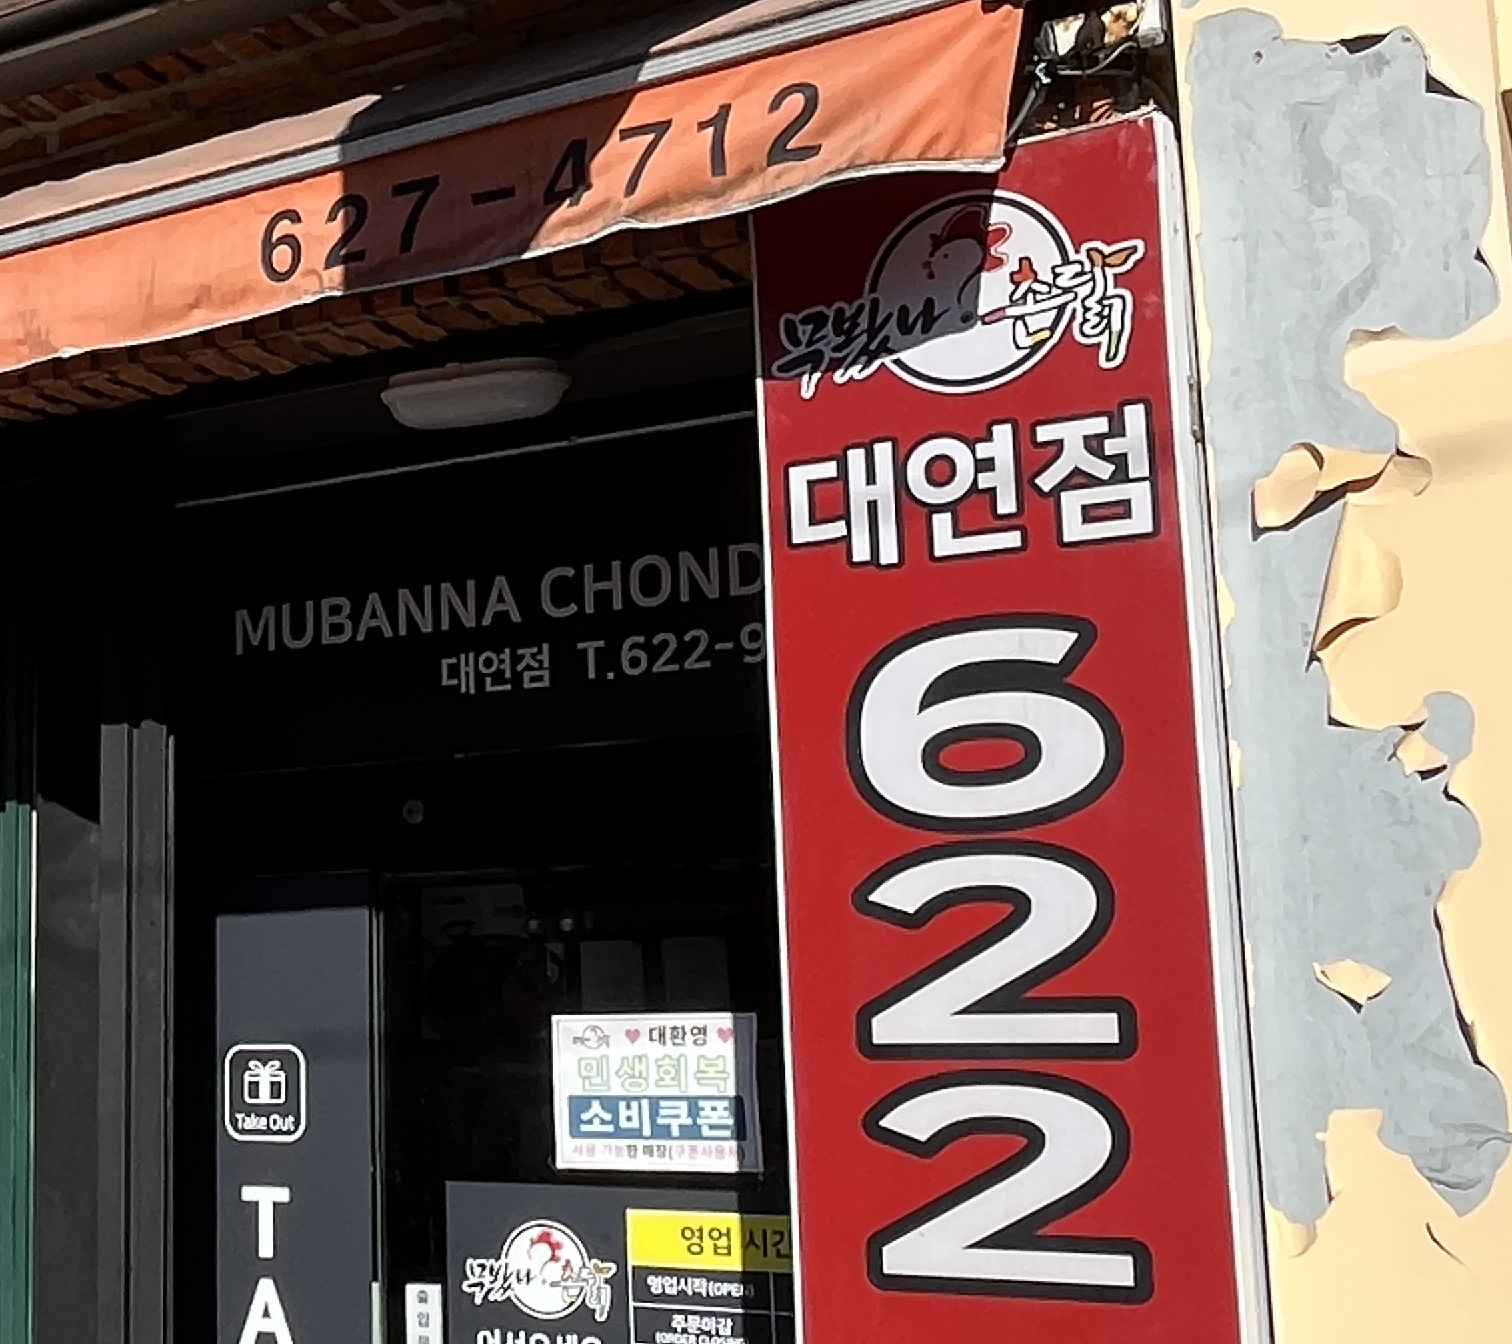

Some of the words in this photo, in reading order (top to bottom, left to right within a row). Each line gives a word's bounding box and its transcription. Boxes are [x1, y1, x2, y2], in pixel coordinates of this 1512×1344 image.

[260, 82, 824, 283] 627-4712
[786, 400, 1158, 569] 대연점
[234, 574, 522, 656] MUBANNA
[540, 542, 764, 619] CHOND
[440, 643, 551, 695] 대연점
[648, 1024, 708, 1047] 대환영
[577, 1053, 730, 1093] 민생회복
[235, 1113, 267, 1130] Take
[269, 1113, 295, 1131] Out
[579, 1098, 734, 1138] 소비쿠폰
[681, 1226, 732, 1257] 영업
